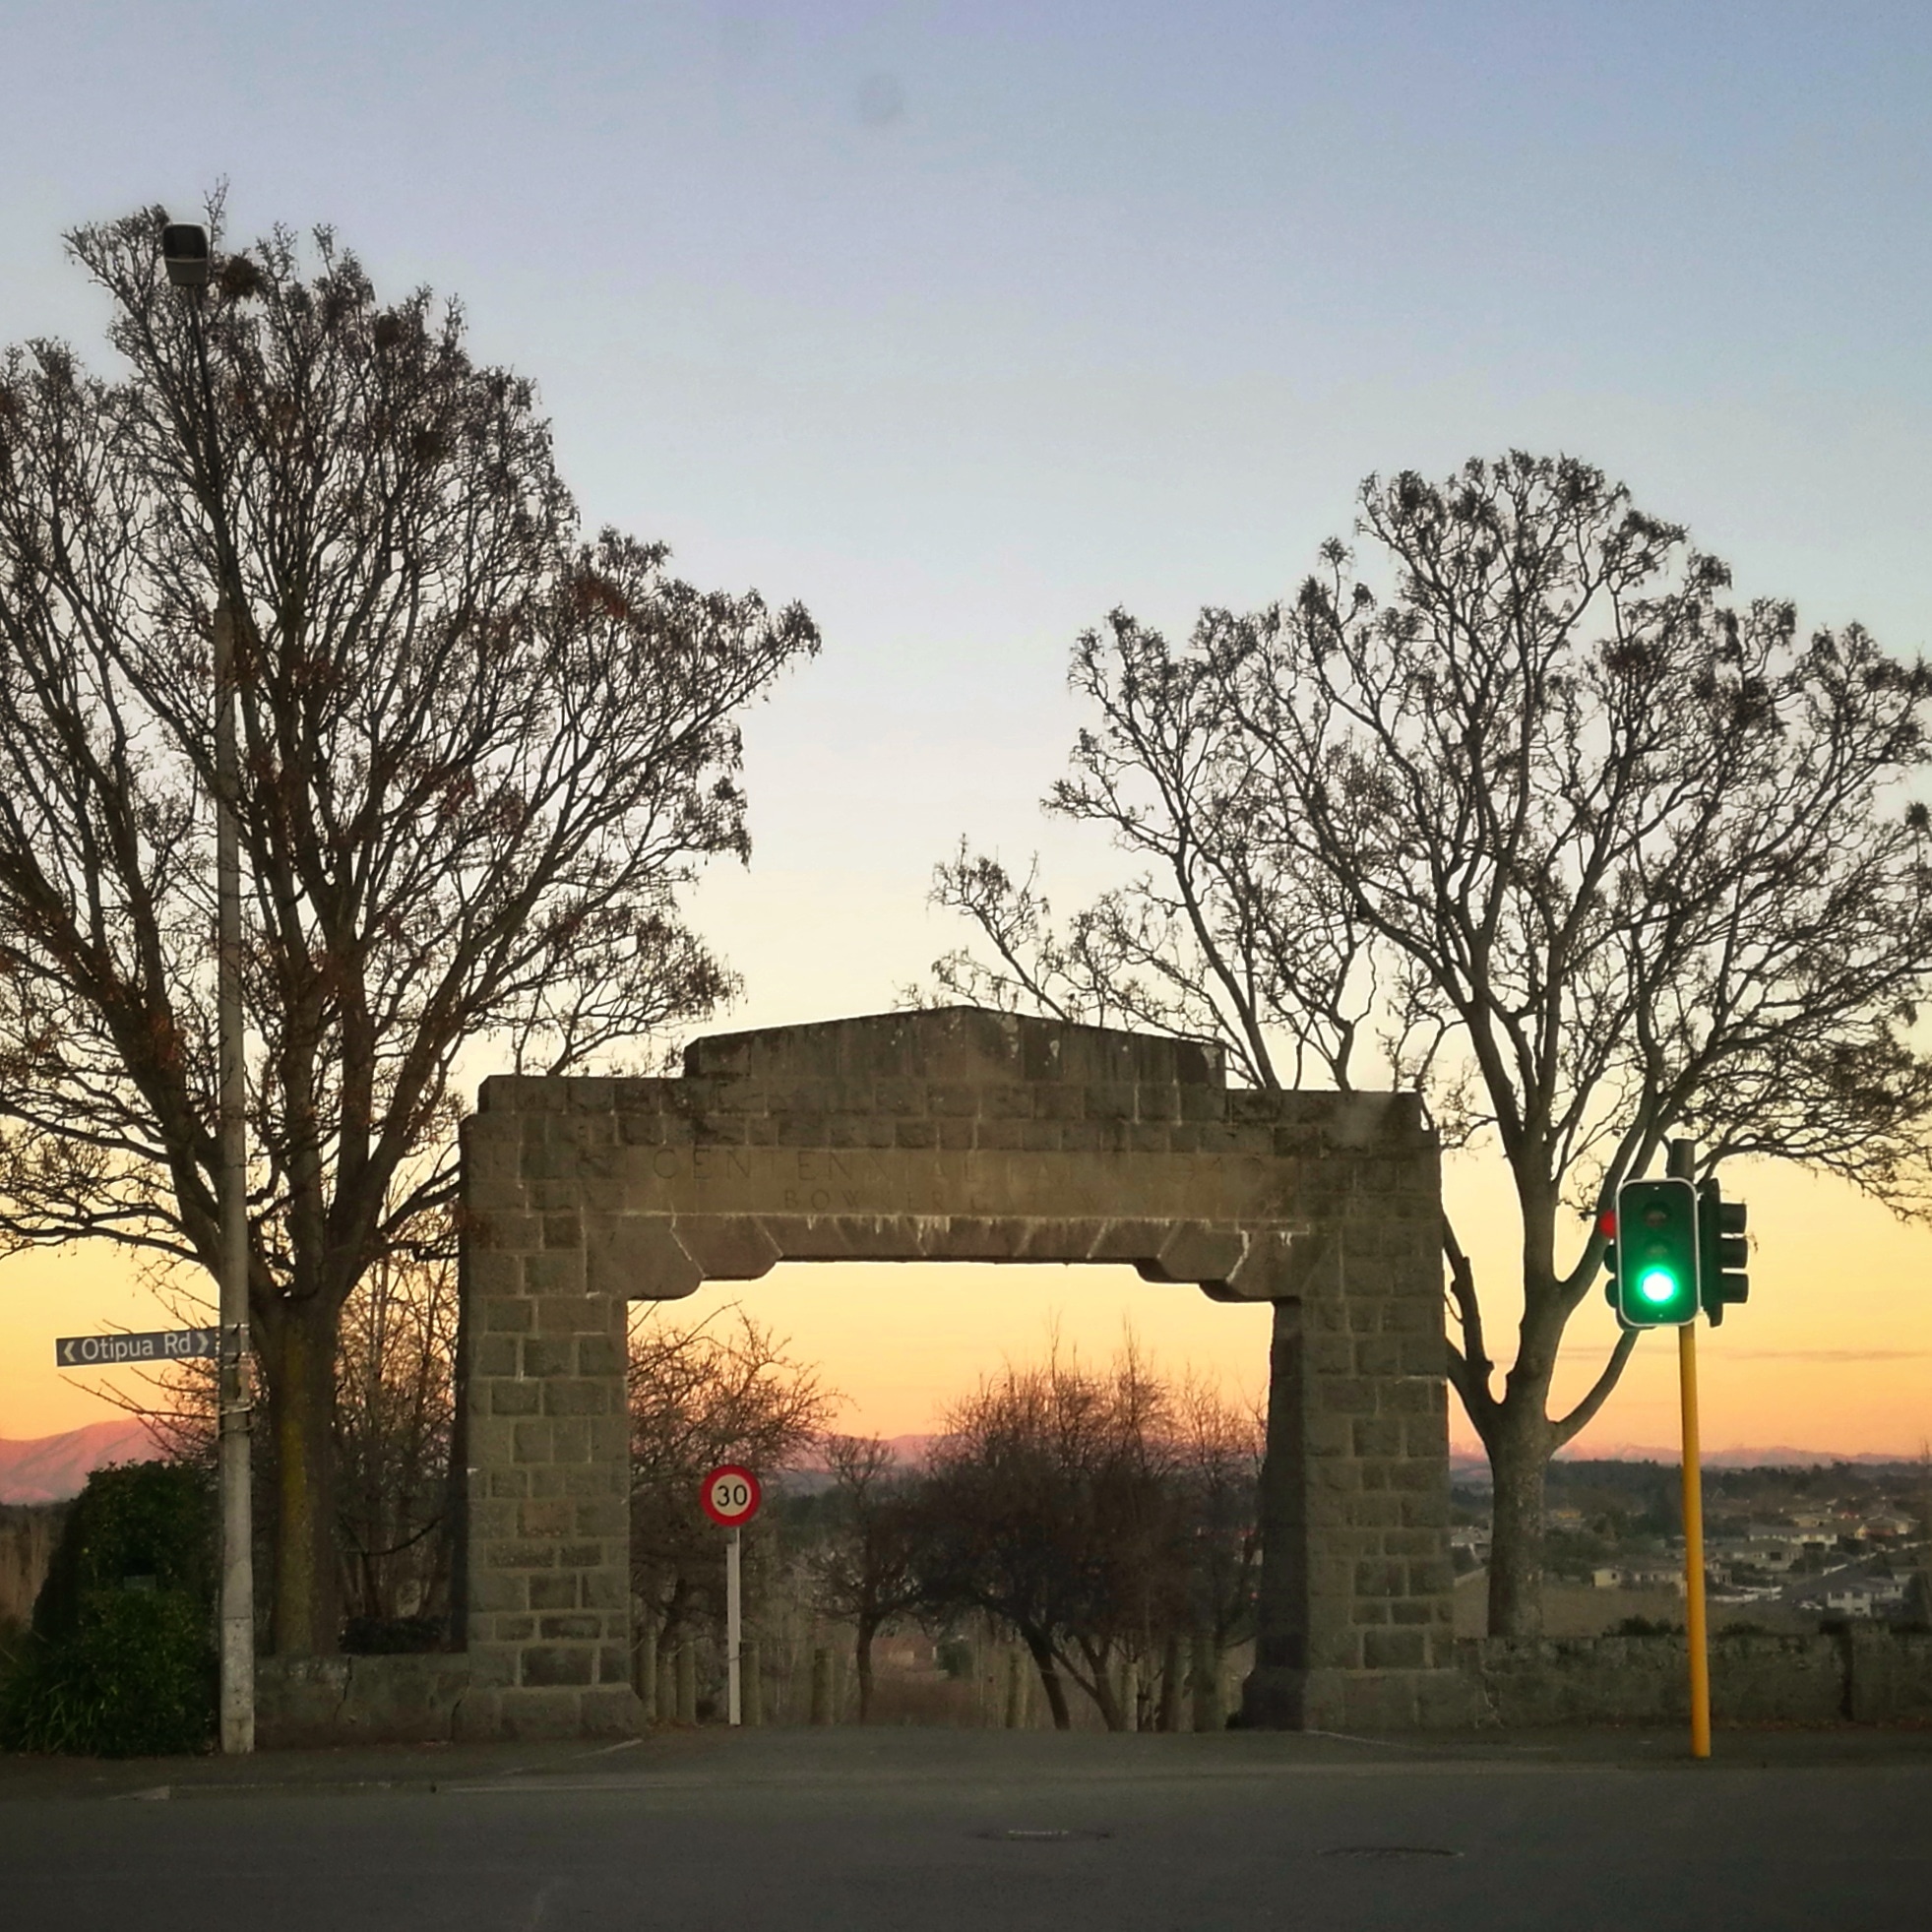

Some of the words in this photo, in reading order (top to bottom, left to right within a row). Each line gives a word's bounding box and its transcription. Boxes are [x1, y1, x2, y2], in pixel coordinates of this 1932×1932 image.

[81, 1337, 155, 1362] Otipua
[163, 1332, 192, 1355] Rd
[717, 1484, 748, 1507] 30
